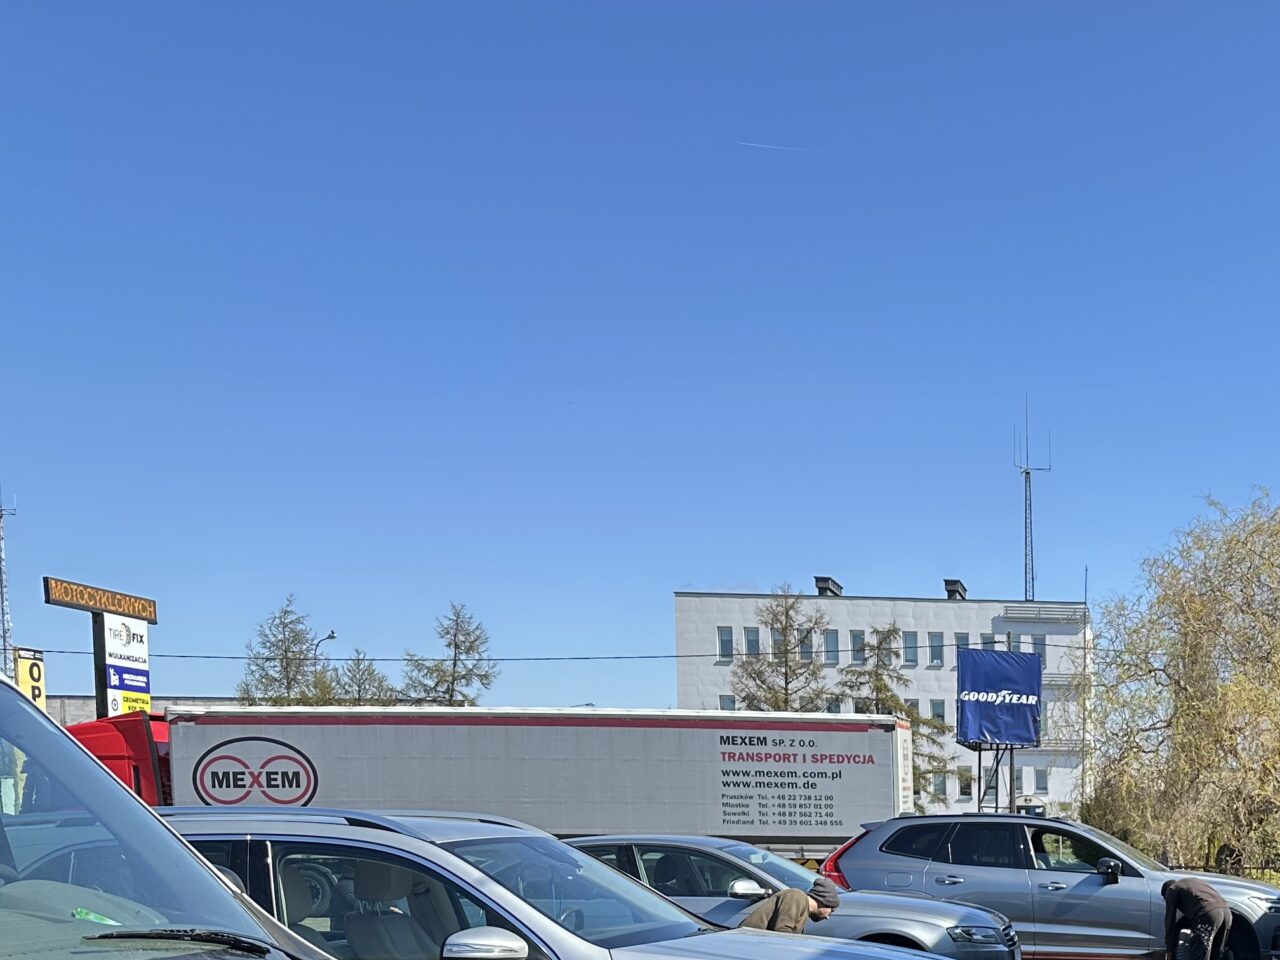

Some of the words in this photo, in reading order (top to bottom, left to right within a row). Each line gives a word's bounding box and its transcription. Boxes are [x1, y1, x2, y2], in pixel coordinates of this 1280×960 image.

[51, 580, 154, 618] MOTOCYKLOWYCH
[108, 628, 124, 641] TIRE
[132, 633, 144, 644] FIX
[108, 652, 147, 664] WULKANIZACJA
[960, 690, 1038, 705] GOODYEAR
[719, 735, 767, 747] MEXEM
[772, 739, 786, 747] SP.
[789, 739, 796, 747] Z
[720, 752, 798, 763] TRANSPORT
[802, 754, 806, 763] I
[811, 754, 875, 764] SPEDYCJA
[210, 771, 301, 789] MEXEM
[721, 769, 842, 780] www.mexem.com.pl
[721, 780, 817, 789] www.mexem.de
